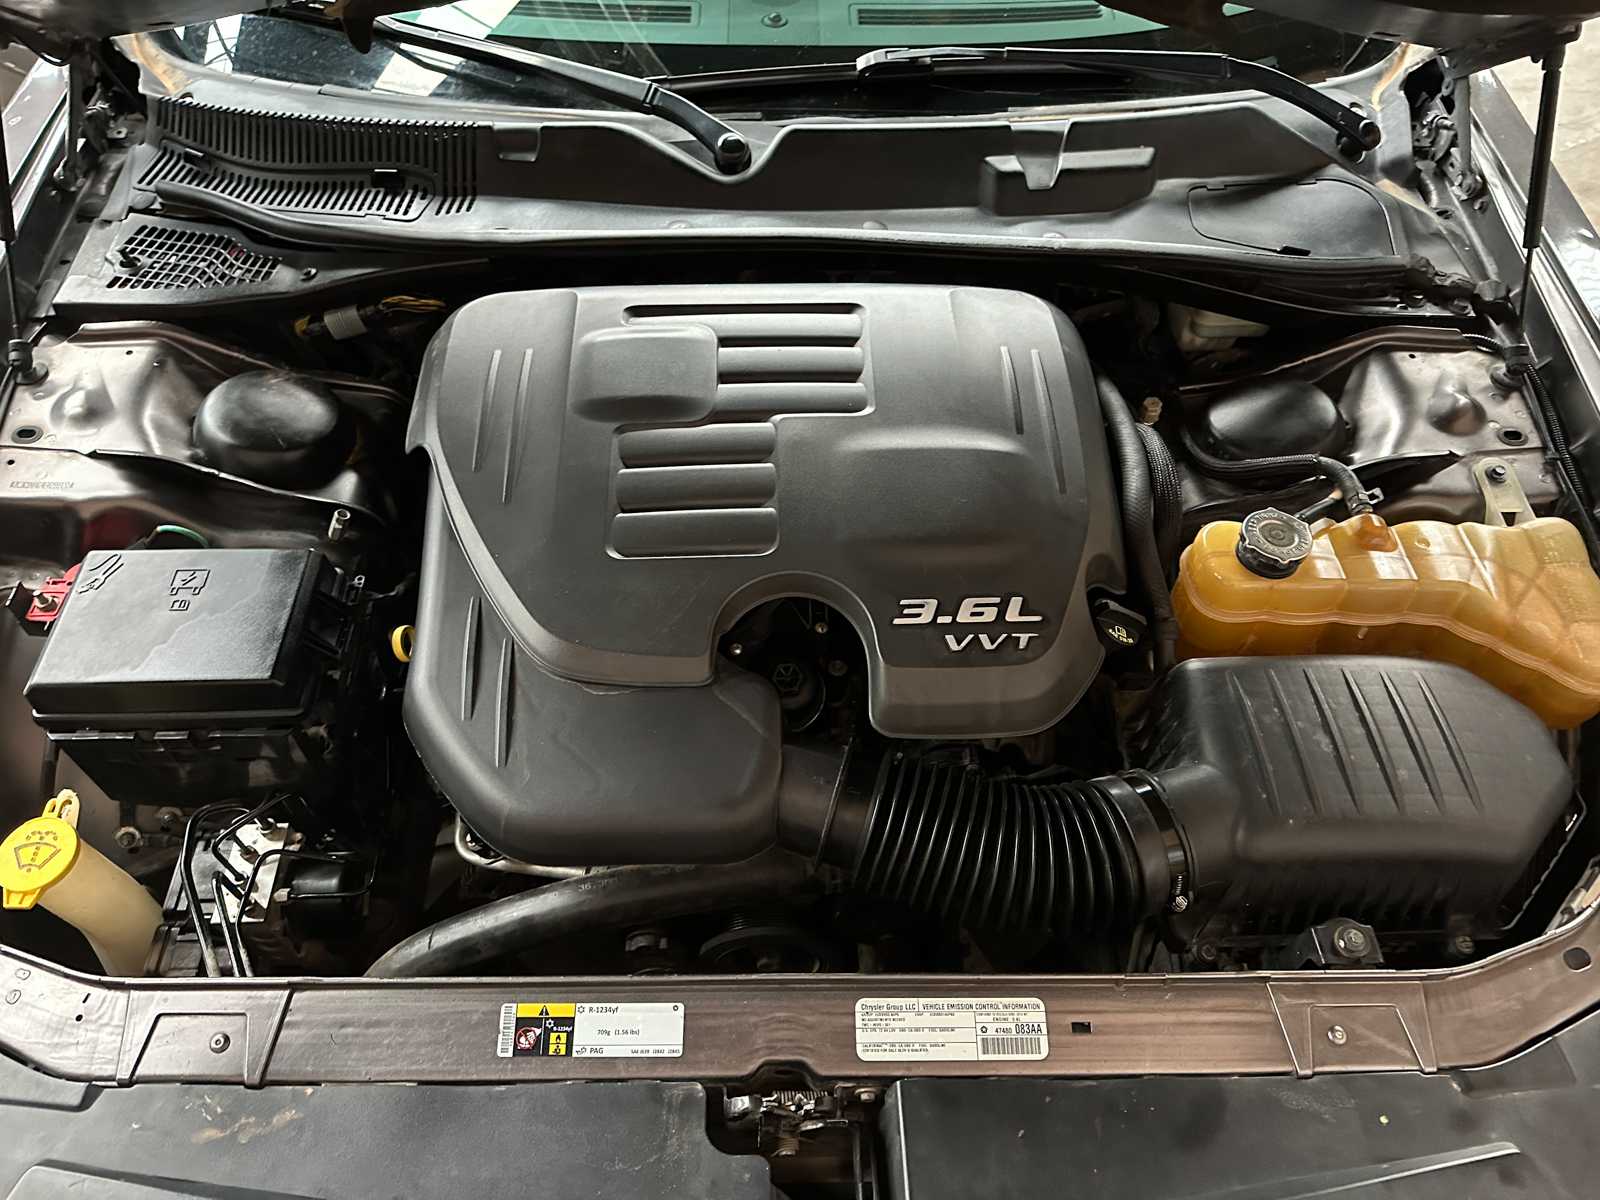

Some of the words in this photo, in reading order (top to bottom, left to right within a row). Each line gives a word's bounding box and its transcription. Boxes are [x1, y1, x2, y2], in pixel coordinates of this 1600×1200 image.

[892, 596, 1043, 625] 3.6L
[944, 633, 1040, 651] VVT
[588, 1006, 619, 1014] R-1234yf
[861, 1003, 885, 1011] Chrysler
[886, 1003, 904, 1011] Group
[1015, 1023, 1043, 1034] 083AA
